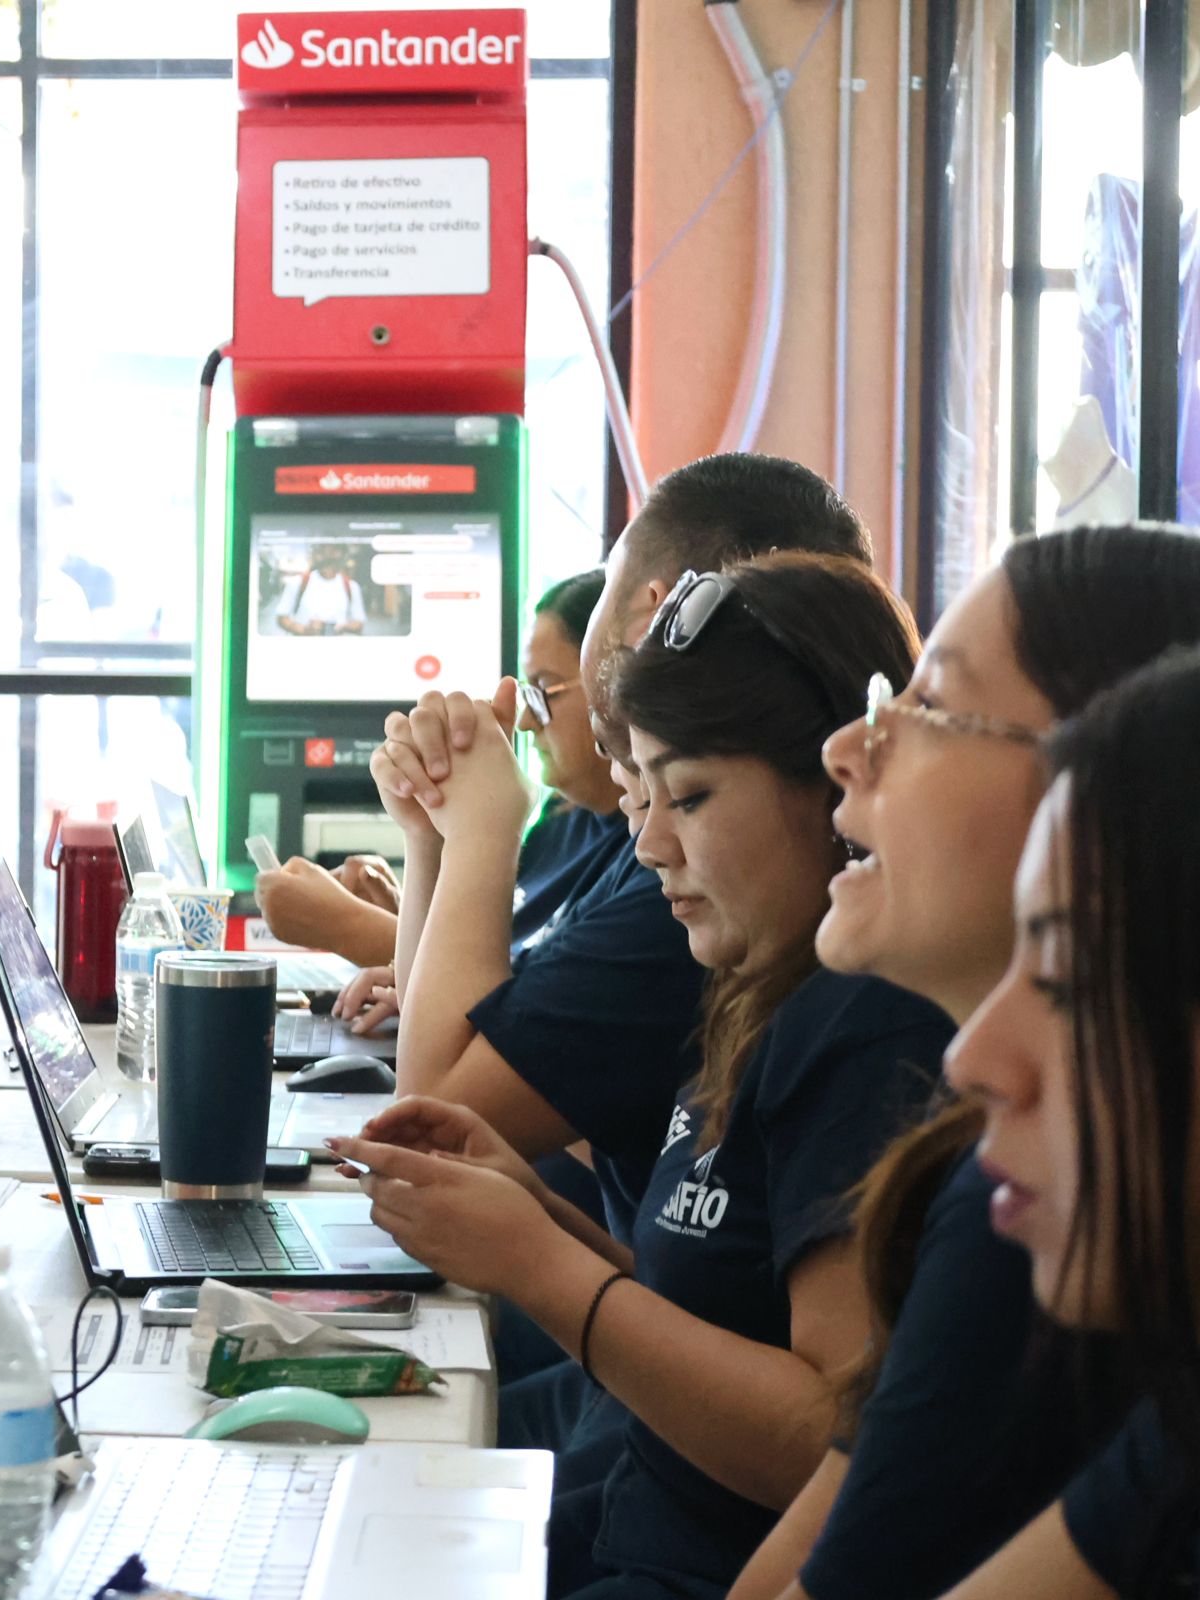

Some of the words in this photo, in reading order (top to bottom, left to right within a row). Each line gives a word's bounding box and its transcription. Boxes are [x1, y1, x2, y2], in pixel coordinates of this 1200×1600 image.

[300, 28, 521, 67] Santander
[293, 177, 336, 189] Retiro
[340, 176, 358, 188] de
[363, 175, 421, 188] efectivo
[293, 199, 339, 211] Saldos
[343, 202, 352, 213] y
[356, 197, 451, 209] movimientos
[293, 222, 327, 236] Pago
[331, 220, 349, 233] de
[354, 221, 402, 235] tarjeta
[407, 219, 424, 232] de
[428, 218, 480, 231] crédito
[293, 244, 327, 259] Pago
[331, 243, 349, 256] de
[354, 242, 416, 255] servicios
[293, 265, 389, 278] Transferencia
[342, 473, 431, 489] Santander
